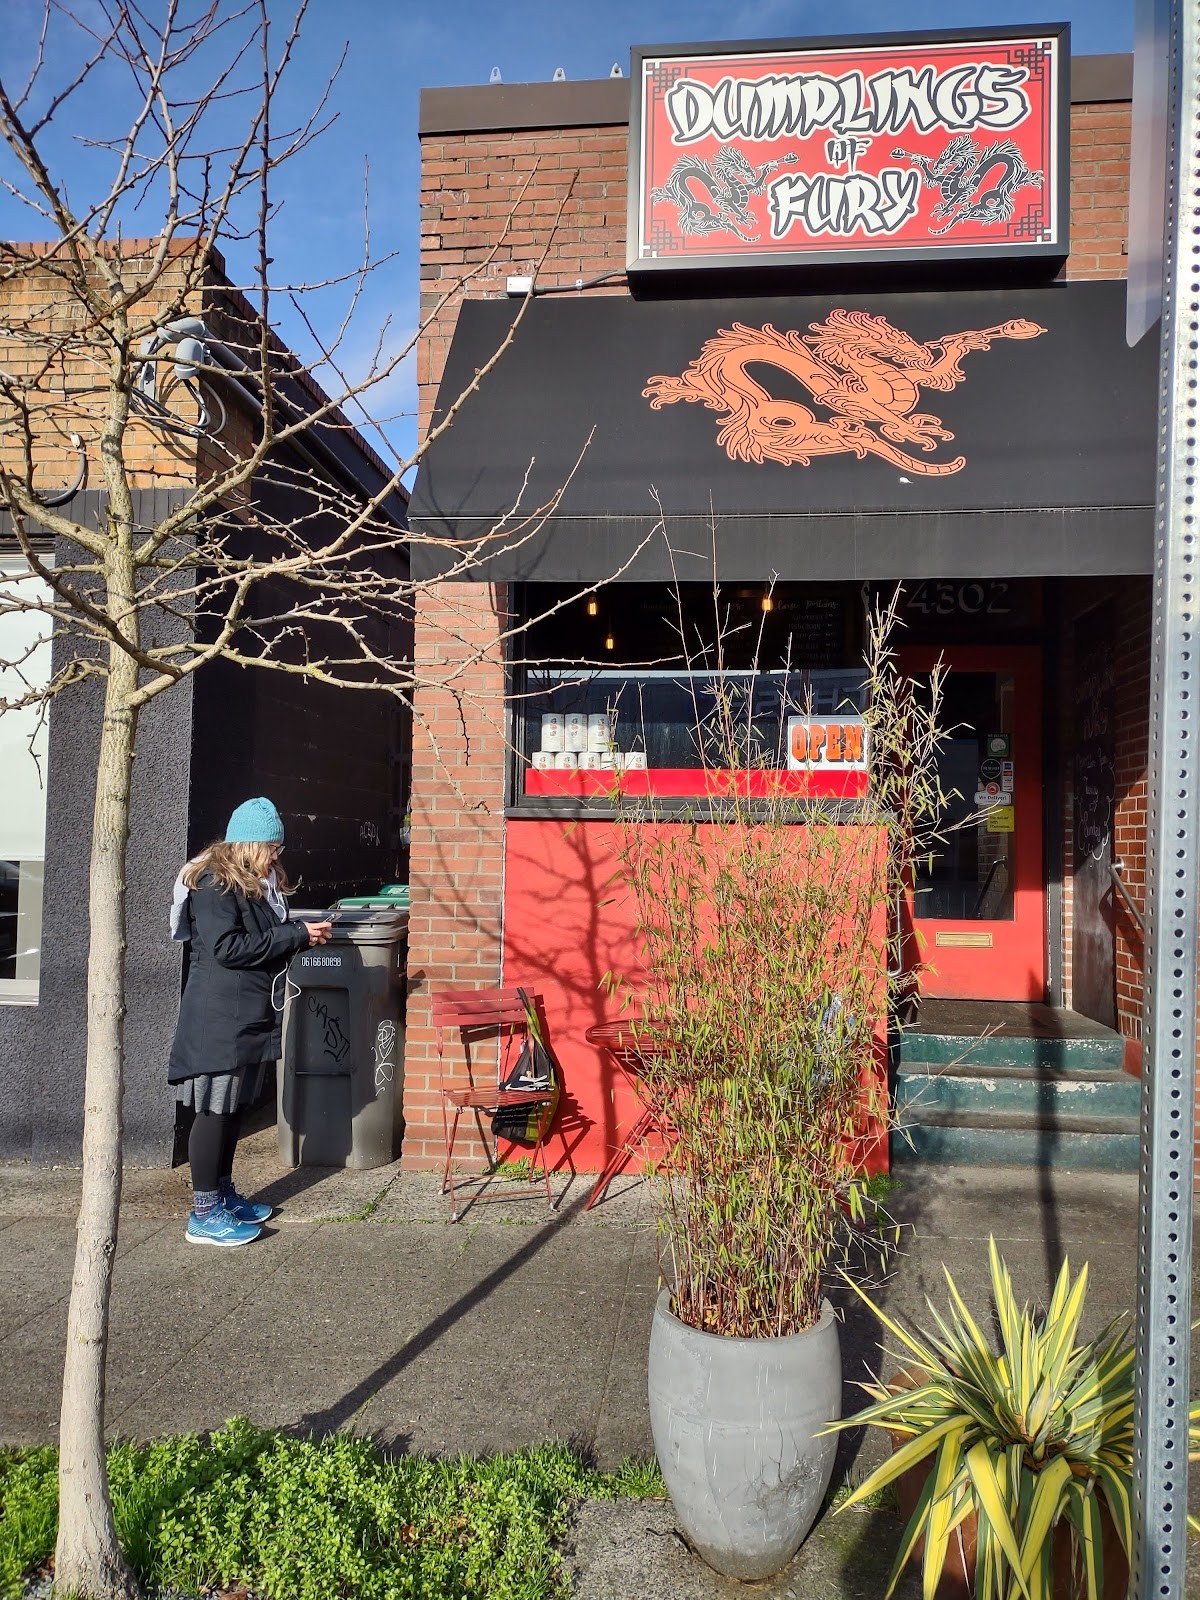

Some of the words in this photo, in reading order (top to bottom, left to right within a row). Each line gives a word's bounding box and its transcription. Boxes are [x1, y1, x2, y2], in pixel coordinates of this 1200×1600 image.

[667, 66, 1029, 144] DUMPLINGS
[827, 137, 871, 172] OF
[769, 170, 919, 237] FURY
[792, 724, 865, 763] OPEN
